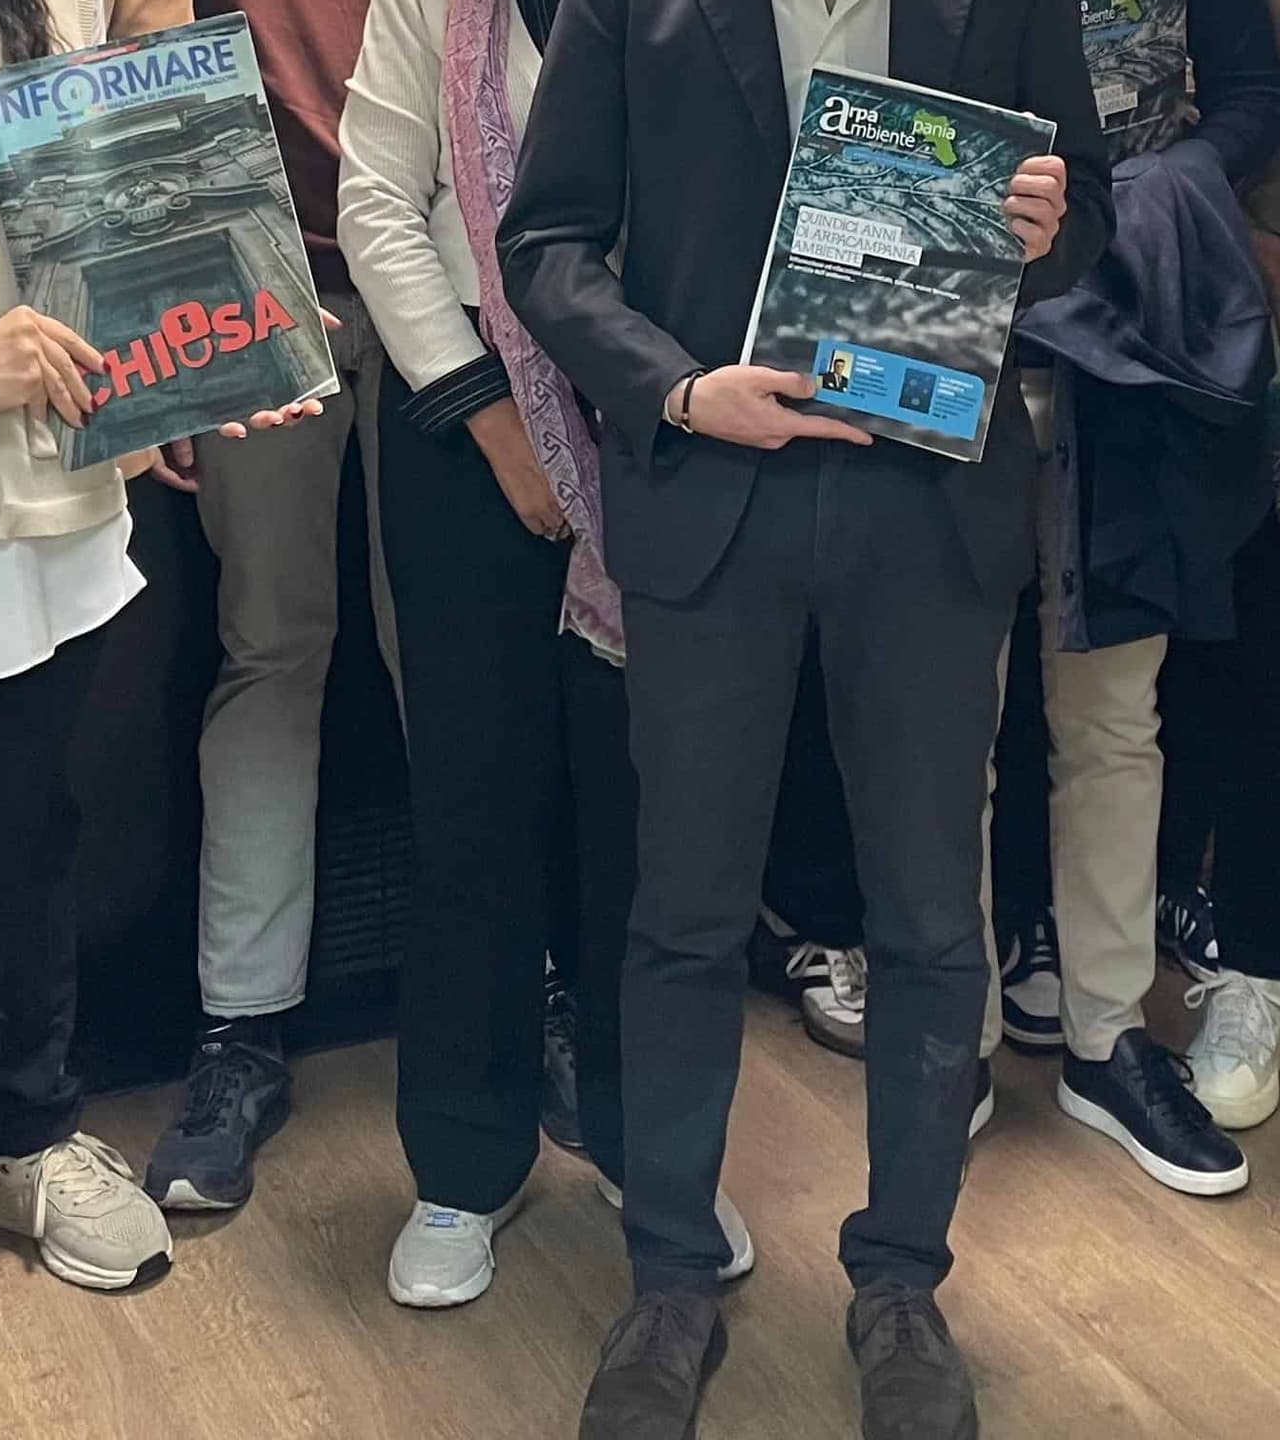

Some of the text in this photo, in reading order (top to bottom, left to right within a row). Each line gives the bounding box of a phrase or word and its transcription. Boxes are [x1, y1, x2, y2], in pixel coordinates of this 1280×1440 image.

[799, 211, 898, 241] QUINDICI ANNI
[794, 240, 862, 264] AMBIENTE
[796, 225, 919, 262] DI ARPACAMPANIA
